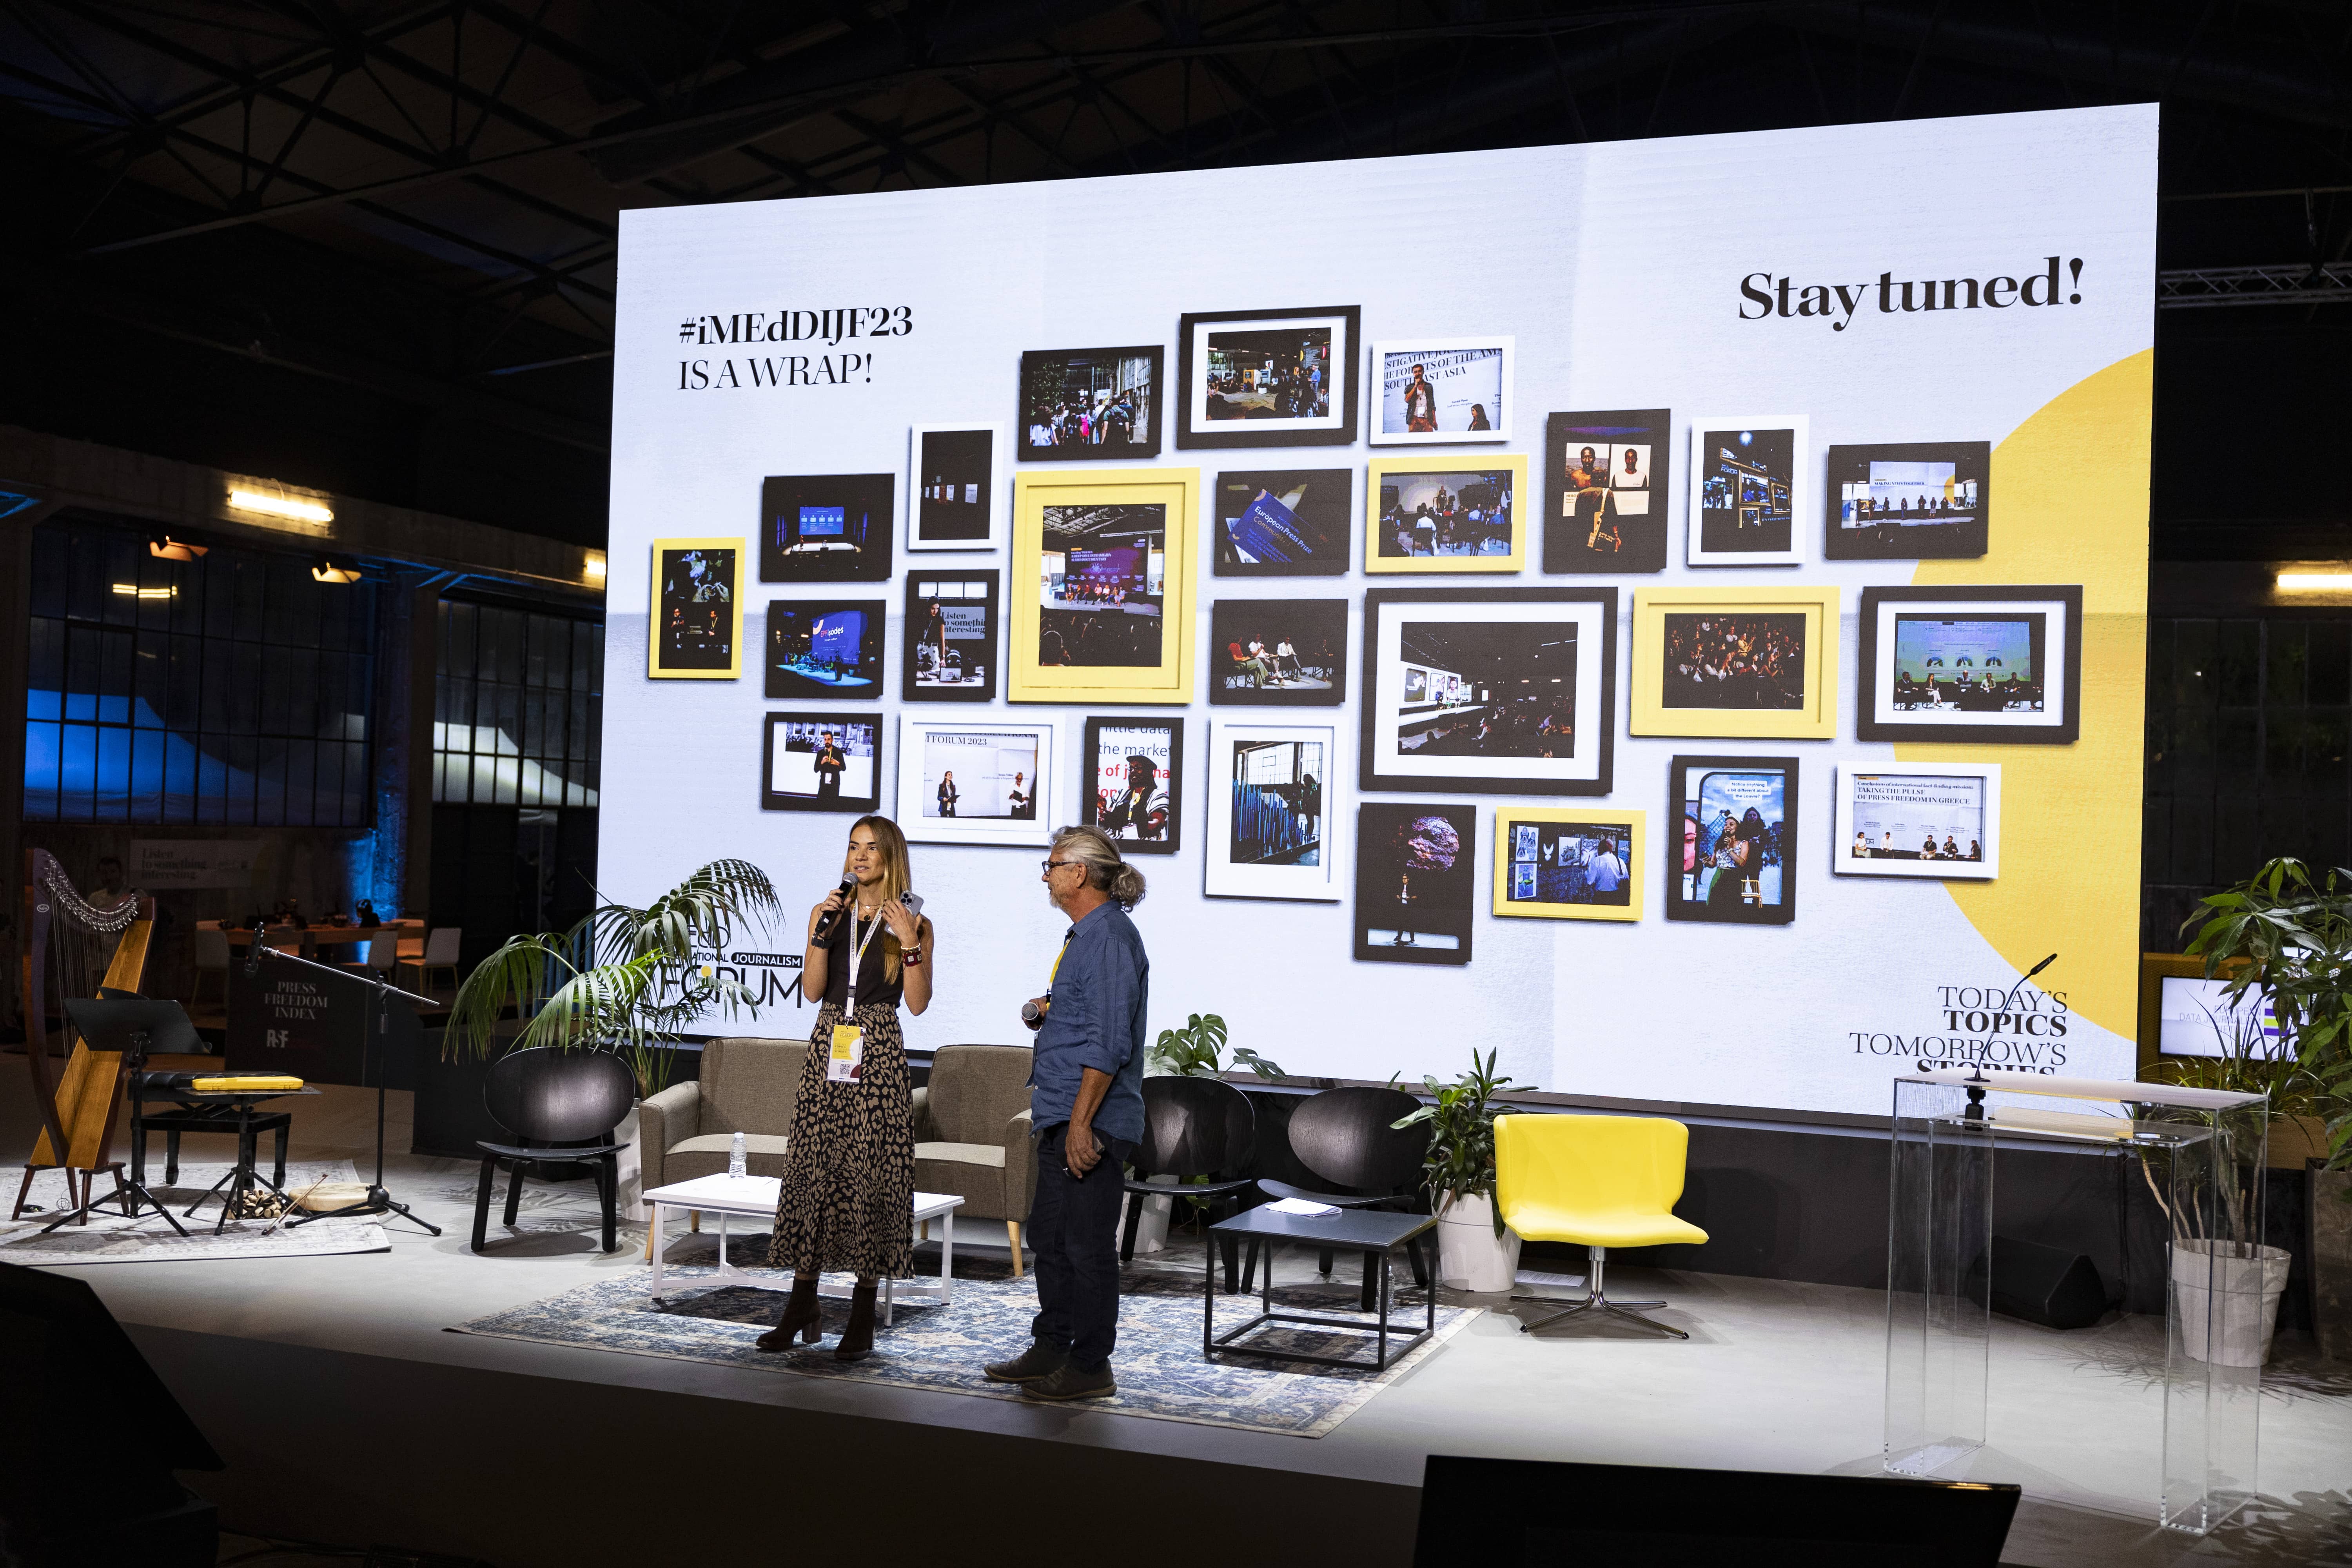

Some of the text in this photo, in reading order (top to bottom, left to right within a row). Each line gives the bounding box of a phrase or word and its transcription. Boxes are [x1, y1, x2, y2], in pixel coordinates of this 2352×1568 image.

[1739, 256, 2084, 331] Stay tuned!
[679, 306, 913, 345] #iMEdDIJF23
[677, 353, 872, 390] IS A WRAP!
[1396, 361, 1436, 377] FORTS
[1438, 357, 1452, 367] OF
[1454, 351, 1477, 364] THE
[1385, 372, 1441, 390] SOUTAST
[1443, 366, 1466, 379] ASIA
[1254, 506, 1284, 532] European
[1284, 528, 1298, 542] Press
[1298, 540, 1312, 554] Prize
[944, 626, 985, 635] nteresting
[932, 736, 965, 745] FORUM
[967, 737, 987, 746] 2023
[1099, 742, 1170, 756] the marke
[1105, 764, 1120, 776] of
[733, 953, 801, 967] JOURNALISM
[278, 981, 317, 995] PRESS
[264, 993, 328, 1008] FREEDOM
[1938, 986, 2068, 1014] TODAY'S
[275, 1007, 317, 1020] INDEX
[1944, 1009, 2068, 1037] TOPICS
[2180, 1012, 2201, 1022] DATA
[266, 1029, 289, 1048] RSF
[1849, 1032, 2067, 1066] TOMORROW'S
